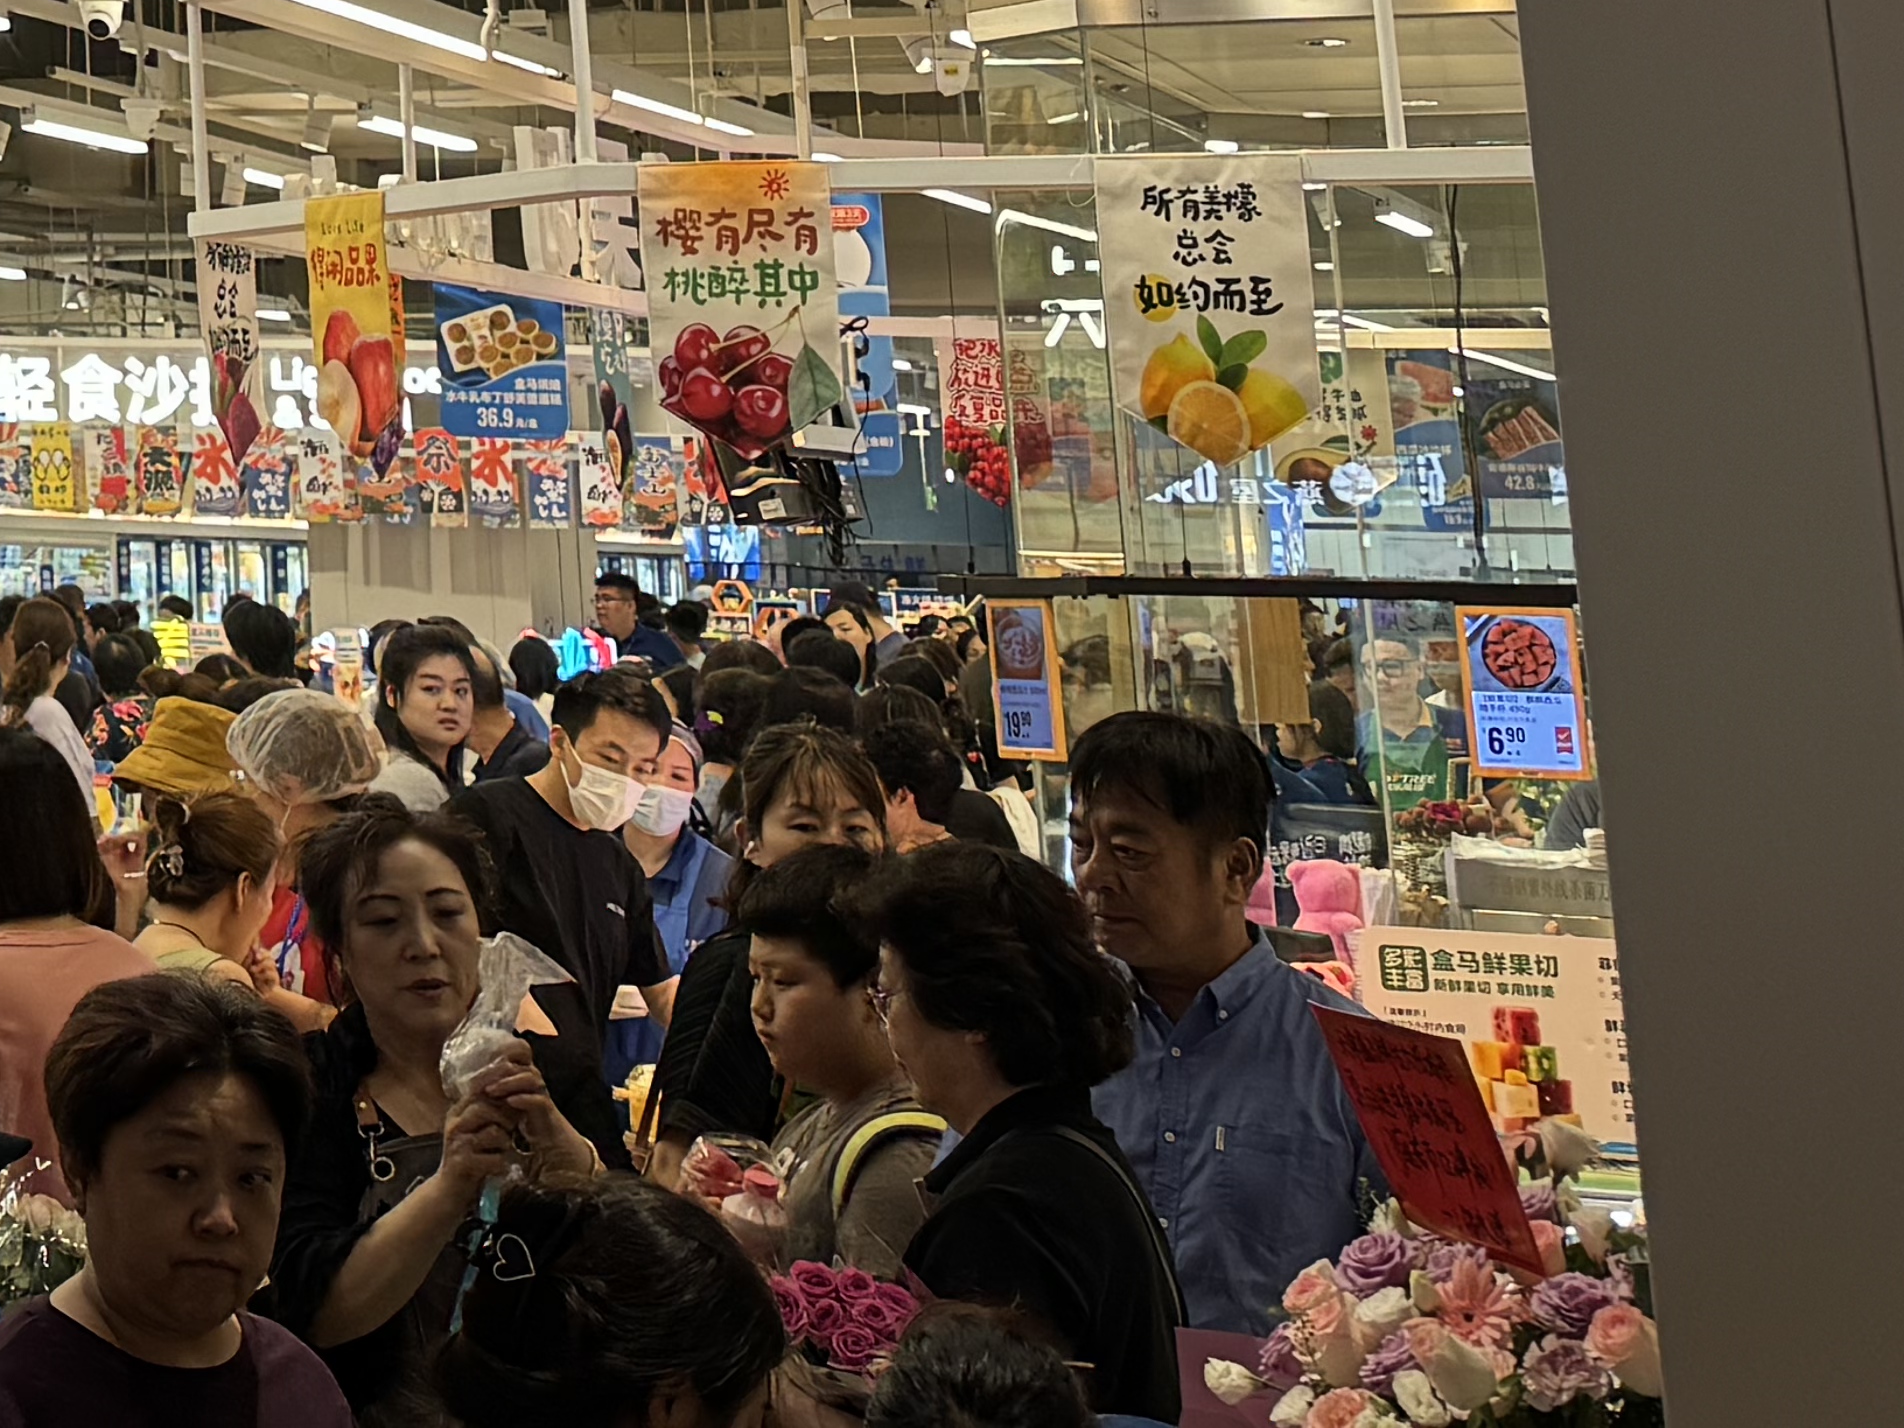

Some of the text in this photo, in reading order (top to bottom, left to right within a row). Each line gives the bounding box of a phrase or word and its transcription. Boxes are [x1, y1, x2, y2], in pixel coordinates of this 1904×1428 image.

[656, 207, 819, 256] 樱有尽有
[1172, 228, 1236, 267] 总会
[661, 258, 820, 309] 桃醉其中
[1134, 274, 1284, 316] 如约而至
[476, 407, 515, 429] 36.9
[1504, 474, 1536, 491] 42.8
[1430, 948, 1559, 978] 盒马鲜果切
